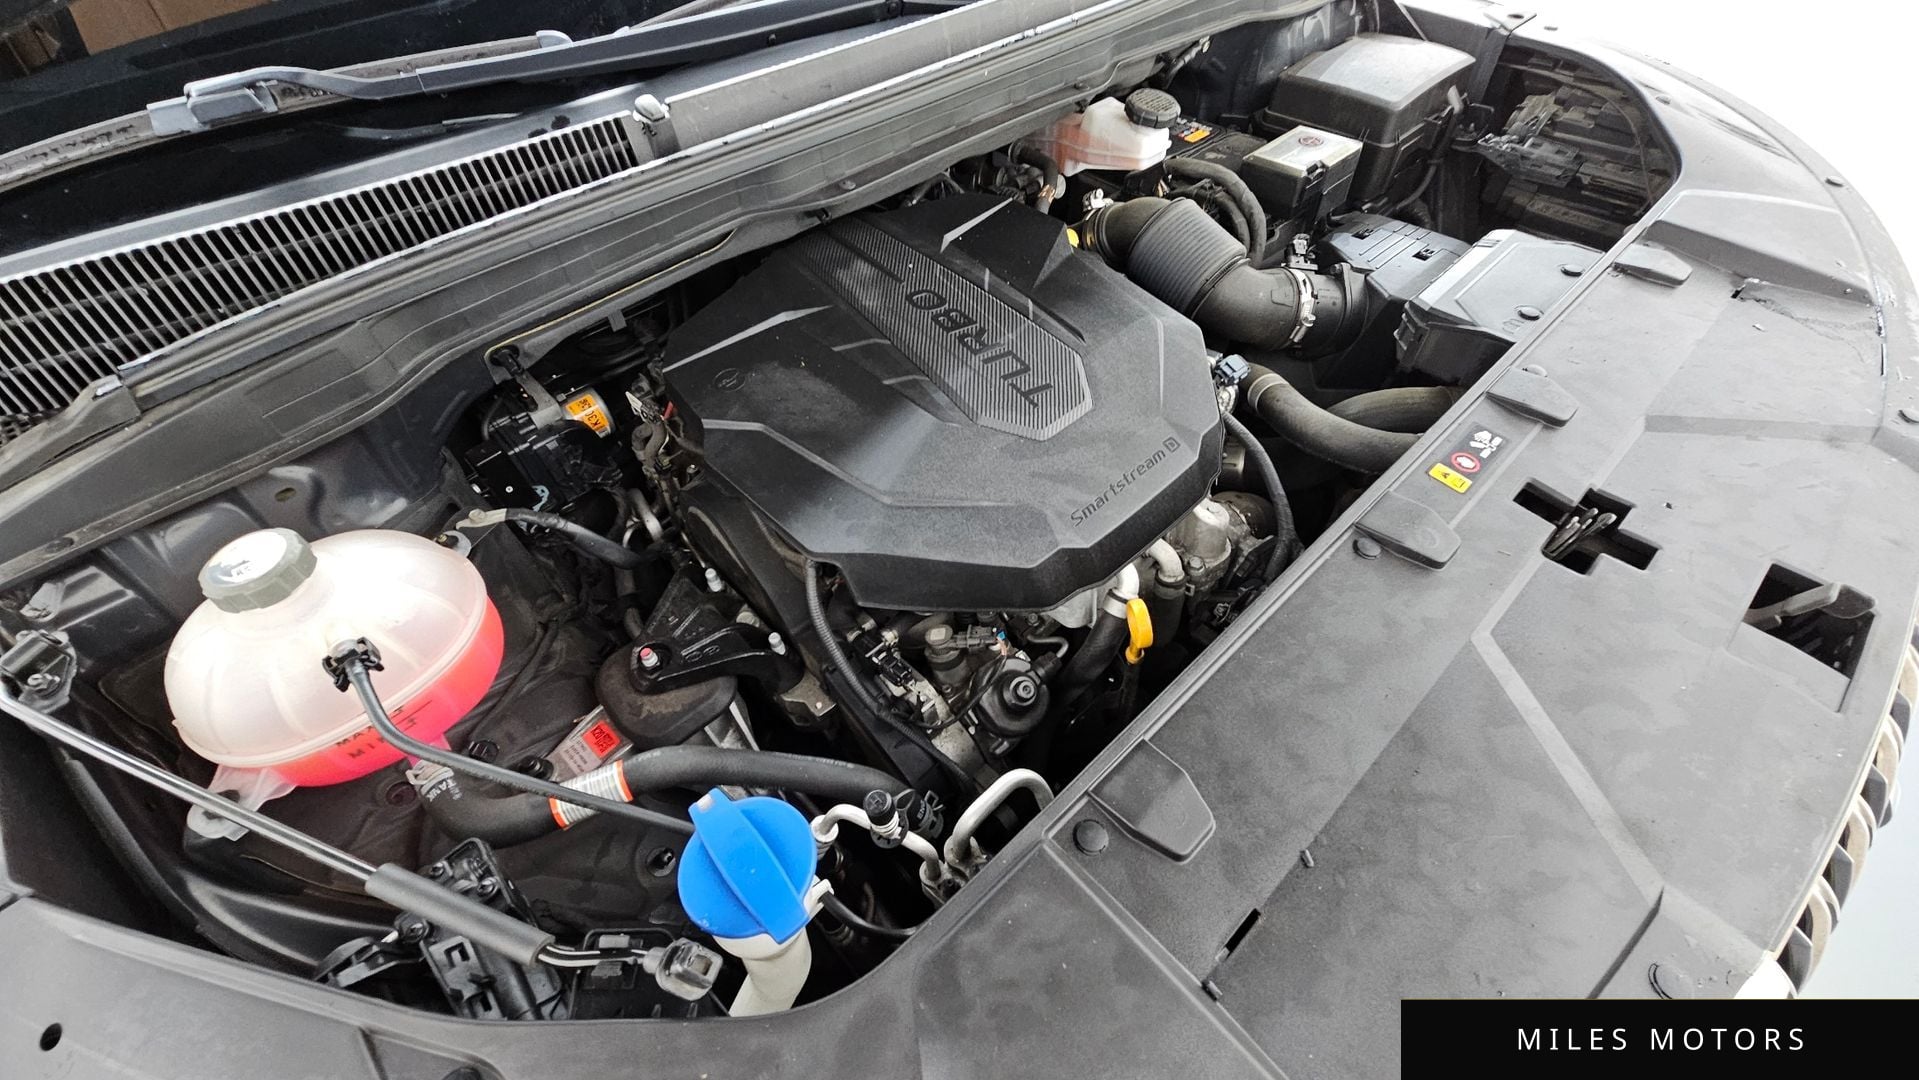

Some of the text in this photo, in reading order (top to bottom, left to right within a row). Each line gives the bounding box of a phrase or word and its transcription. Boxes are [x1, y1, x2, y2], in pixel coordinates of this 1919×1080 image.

[906, 289, 1053, 409] TURBO
[1070, 449, 1166, 527] Smartstream
[425, 778, 457, 802] TANK
